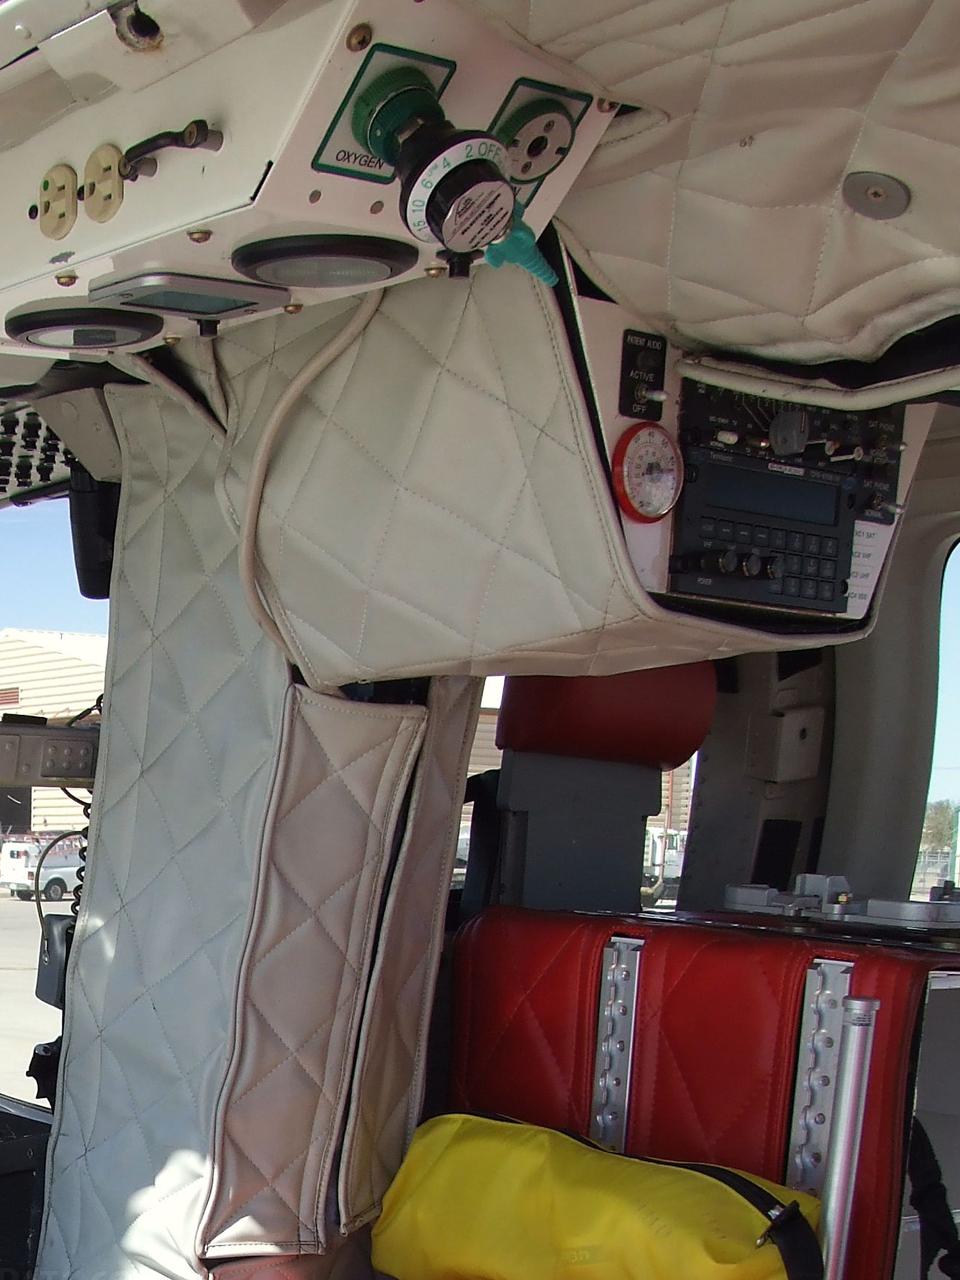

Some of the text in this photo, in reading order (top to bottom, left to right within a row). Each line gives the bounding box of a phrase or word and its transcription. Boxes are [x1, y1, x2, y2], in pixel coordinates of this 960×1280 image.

[335, 150, 385, 170] OXYGEN
[421, 179, 433, 189] 6
[465, 144, 474, 159] 2
[478, 142, 503, 161] OFF
[629, 369, 657, 383] ACTIVE
[632, 403, 648, 414] OFF
